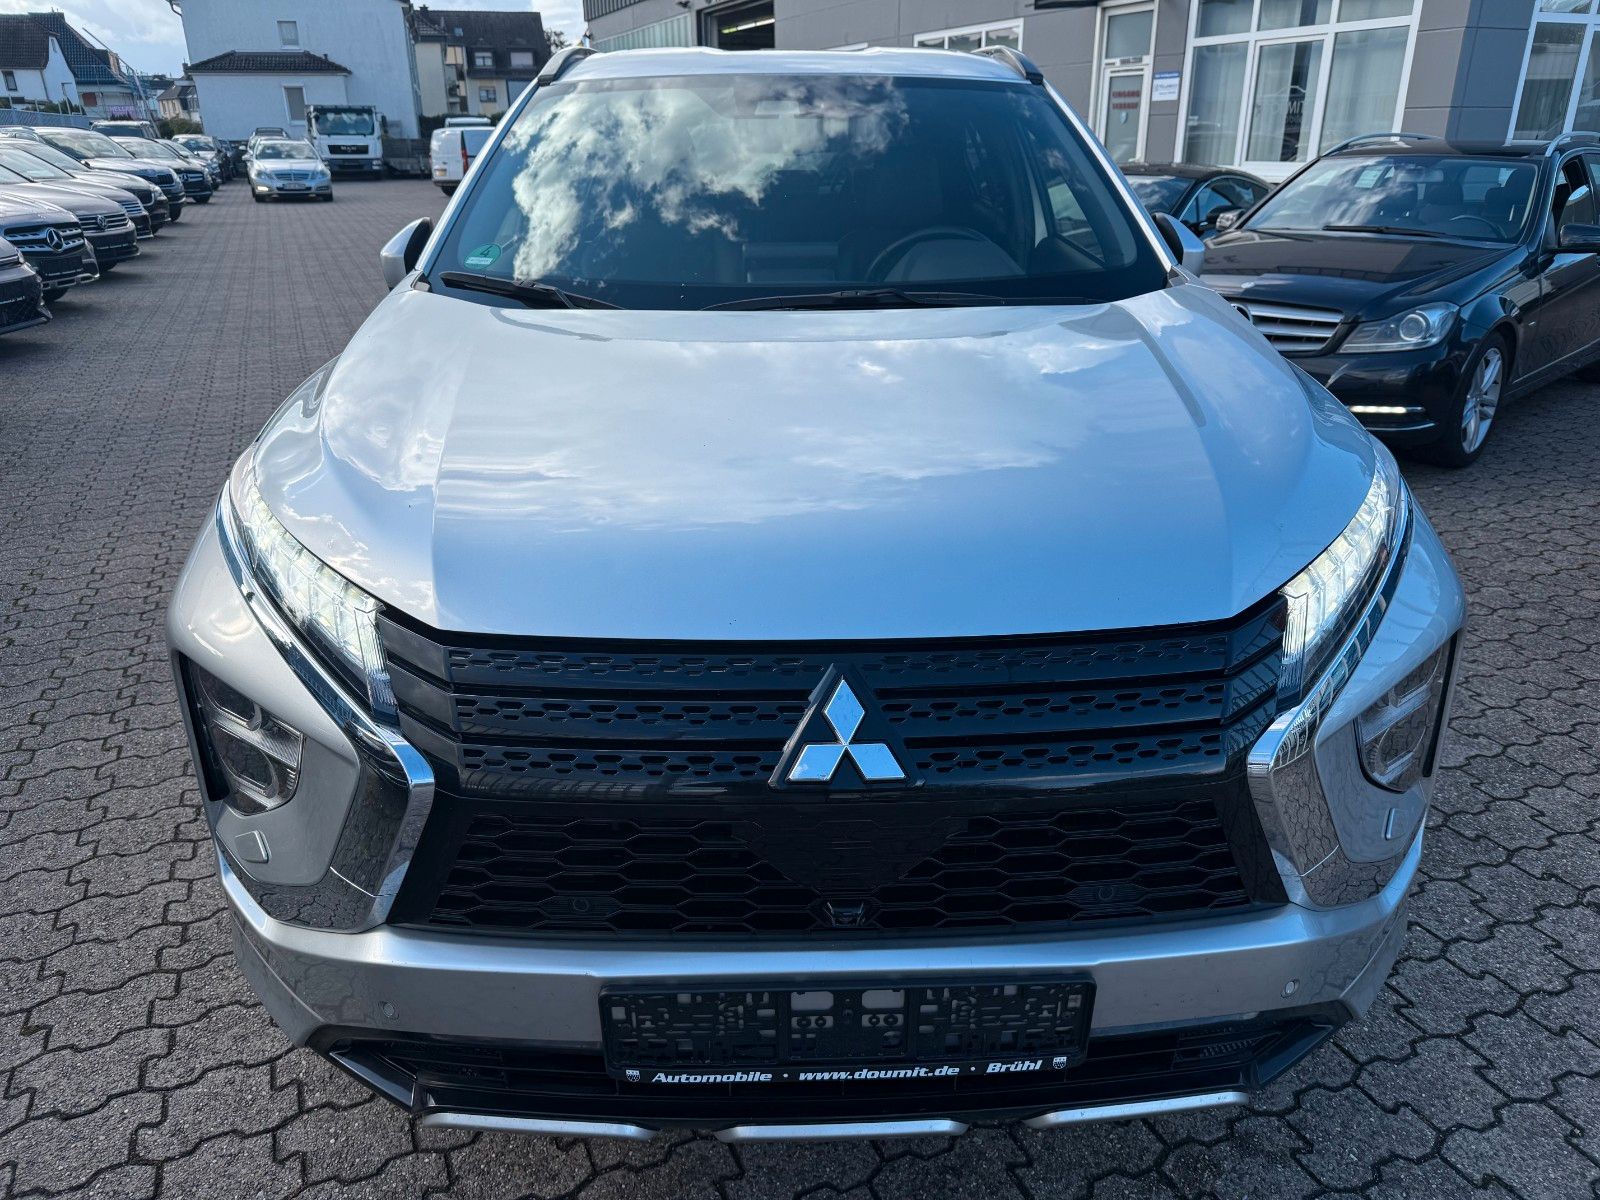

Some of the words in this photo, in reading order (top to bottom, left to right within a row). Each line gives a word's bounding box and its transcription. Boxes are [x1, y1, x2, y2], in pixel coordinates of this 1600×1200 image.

[651, 1071, 773, 1083] Automobile
[799, 1065, 960, 1081] www.doumit.de
[986, 1059, 1043, 1074] Brühl
